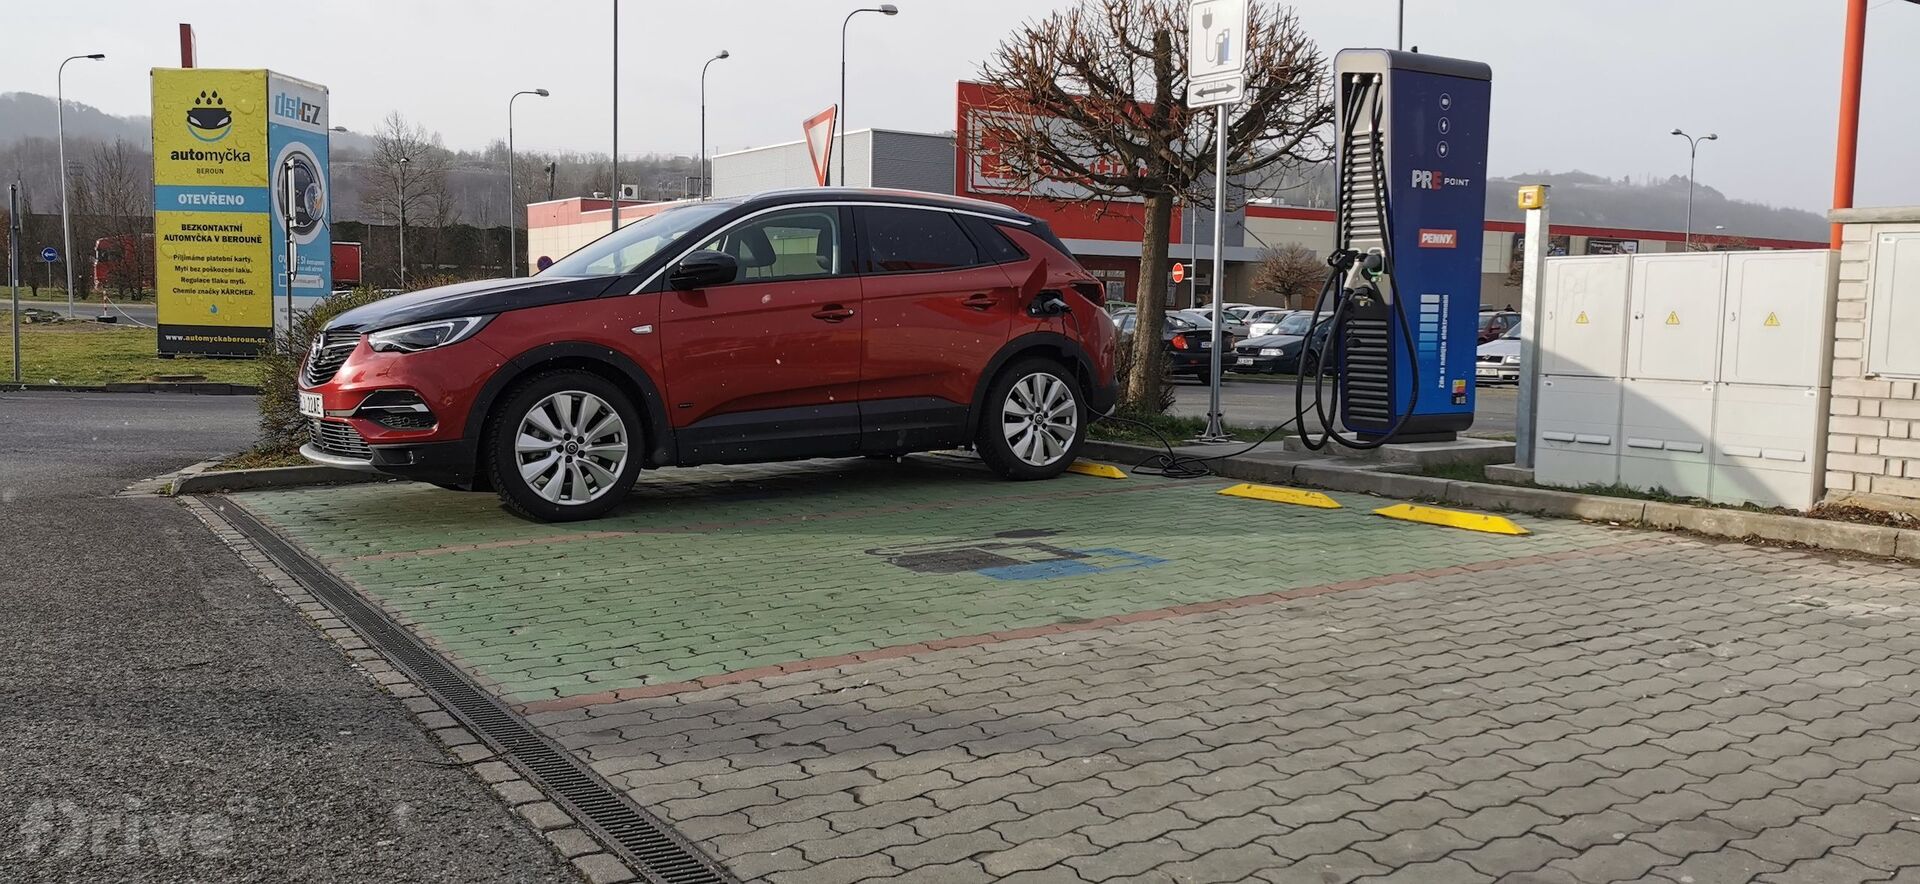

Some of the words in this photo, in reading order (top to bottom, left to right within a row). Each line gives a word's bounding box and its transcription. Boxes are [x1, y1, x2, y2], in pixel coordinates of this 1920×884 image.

[170, 148, 251, 164] automyčka
[1411, 169, 1442, 190] PRE
[1444, 177, 1470, 186] POINT
[178, 191, 245, 206] OTEVŘENO
[181, 223, 243, 232] BEZKONTAKTNÍ
[164, 233, 213, 243] AUTOMYČKA
[214, 235, 220, 243] V
[222, 235, 262, 244] BEROUNĚ
[234, 255, 253, 263] karty.
[202, 266, 234, 274] poškození
[197, 287, 220, 295] značky
[165, 334, 266, 343] www.automyckaberoun.cz
